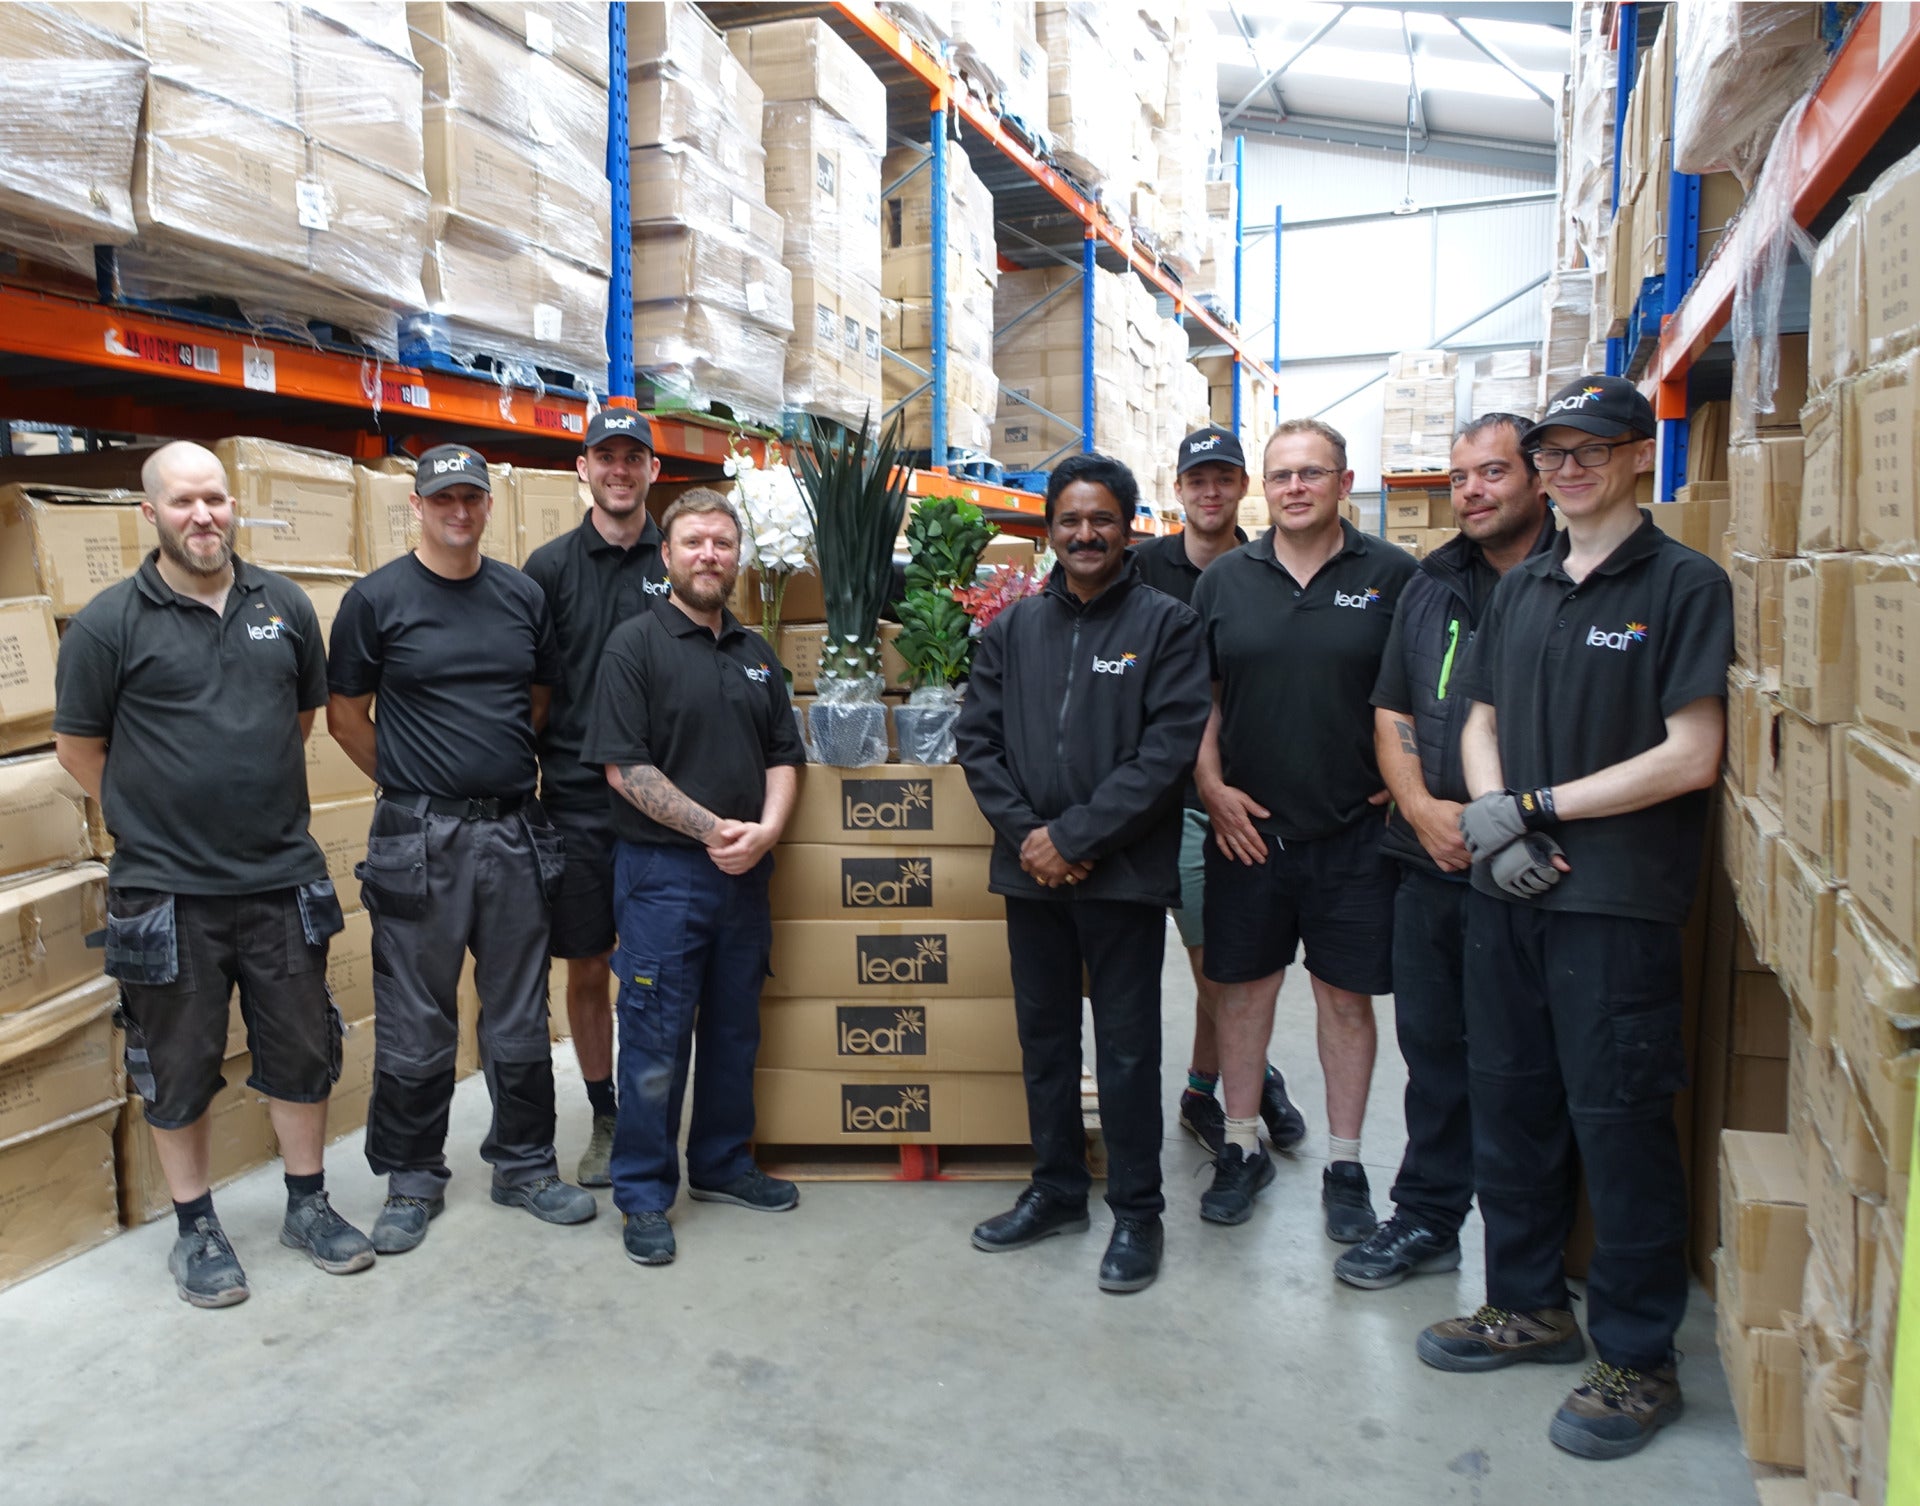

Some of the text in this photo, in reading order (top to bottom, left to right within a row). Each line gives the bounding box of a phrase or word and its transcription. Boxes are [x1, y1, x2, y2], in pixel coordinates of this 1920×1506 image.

[178, 344, 192, 366] 49
[604, 416, 631, 430] leaf
[1190, 438, 1216, 454] leaf
[433, 457, 466, 474] leaf
[1334, 589, 1371, 610] leaf
[245, 622, 280, 641] leaf
[1585, 625, 1637, 652] leaf
[1092, 654, 1129, 675] leaf
[846, 794, 915, 828] leaf
[846, 873, 915, 906] leaf
[861, 950, 932, 982] leaf
[841, 1020, 910, 1054] leaf
[846, 1098, 915, 1131] leaf
